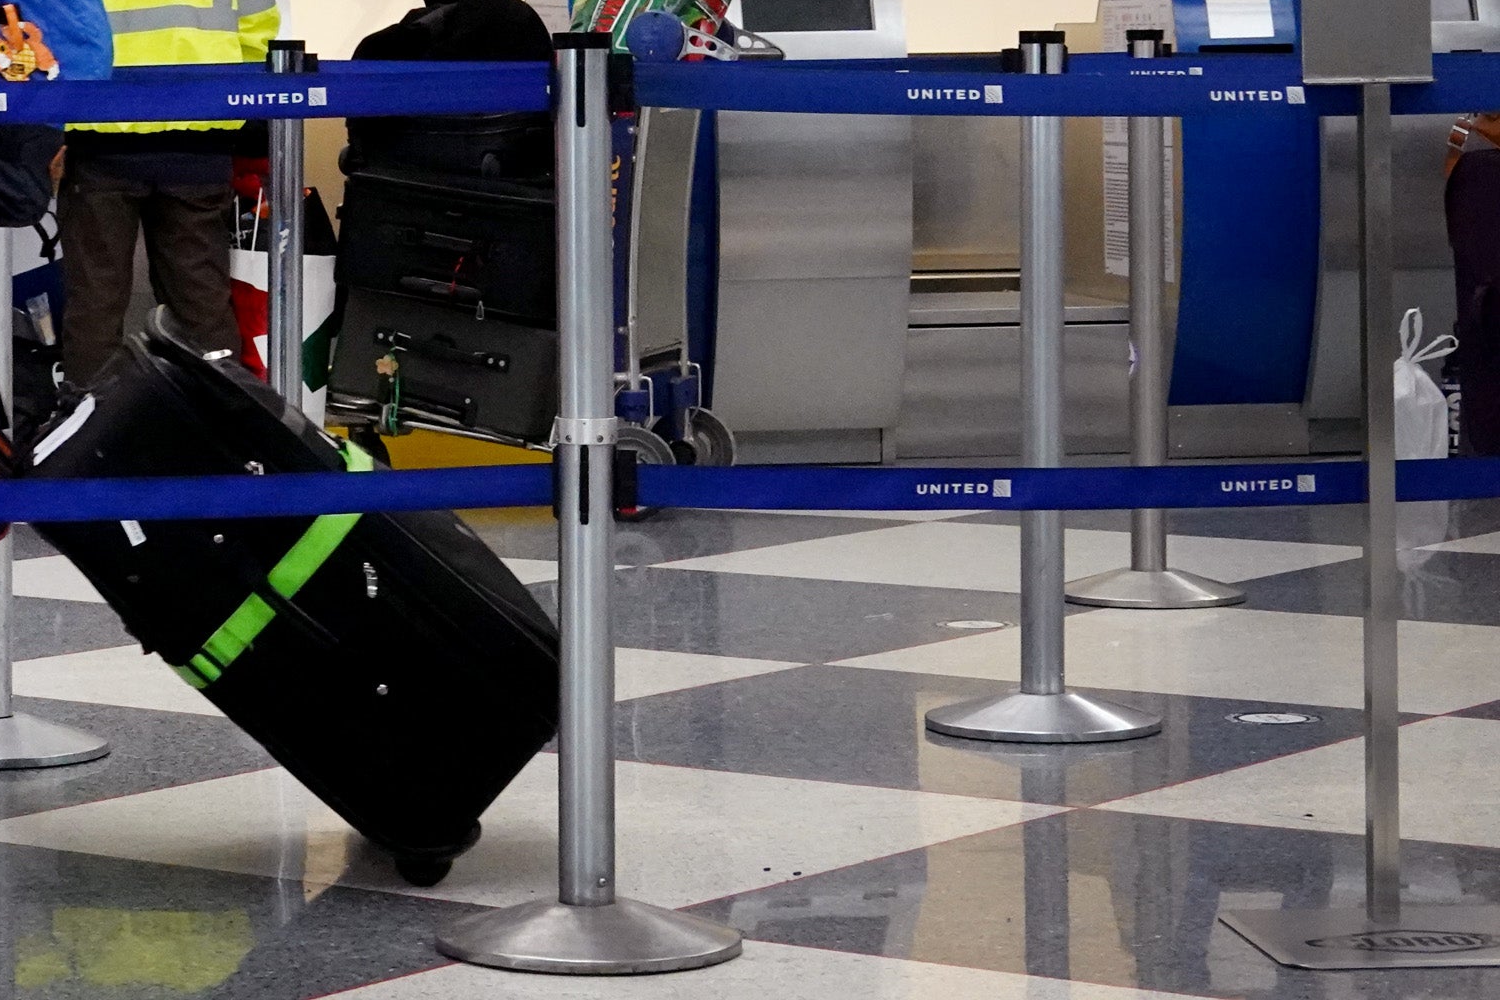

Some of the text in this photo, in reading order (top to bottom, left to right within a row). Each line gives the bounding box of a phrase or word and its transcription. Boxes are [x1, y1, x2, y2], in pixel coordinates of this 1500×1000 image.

[227, 92, 304, 106] UNITED
[907, 88, 981, 100] UNITED
[1210, 90, 1283, 102] UNITED
[916, 484, 989, 495] UNITED
[1221, 480, 1293, 492] UNITED
